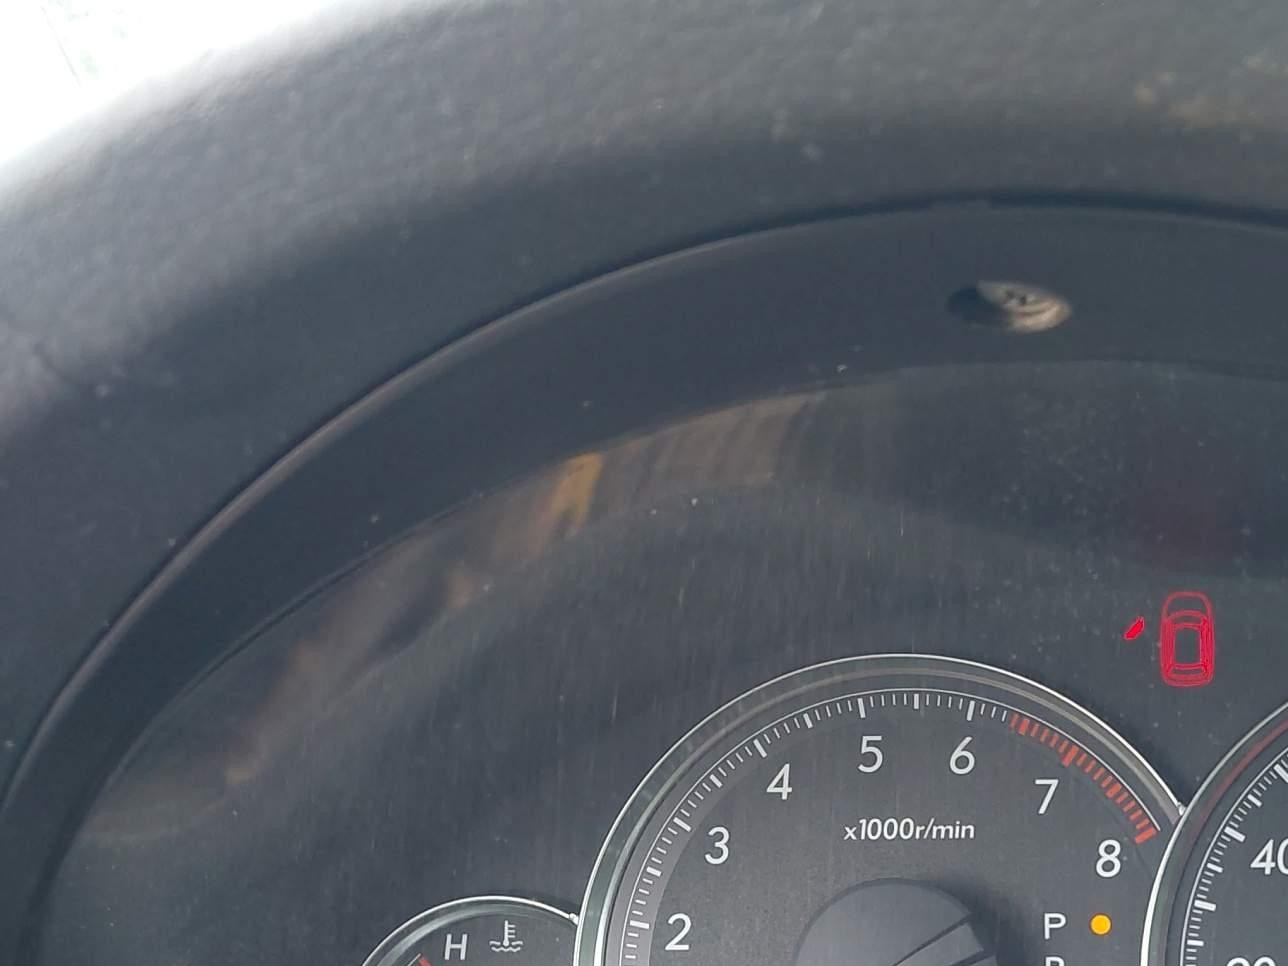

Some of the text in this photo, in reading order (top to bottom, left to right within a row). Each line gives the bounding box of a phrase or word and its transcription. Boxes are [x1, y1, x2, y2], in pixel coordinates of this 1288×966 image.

[858, 736, 882, 772] 5
[950, 737, 974, 774] 6
[767, 764, 792, 799] 4
[1035, 780, 1058, 813] 7
[705, 827, 729, 864] 3
[1096, 840, 1120, 877] 8
[665, 914, 691, 950] 2
[1045, 913, 1066, 939] P
[445, 934, 467, 960] H
